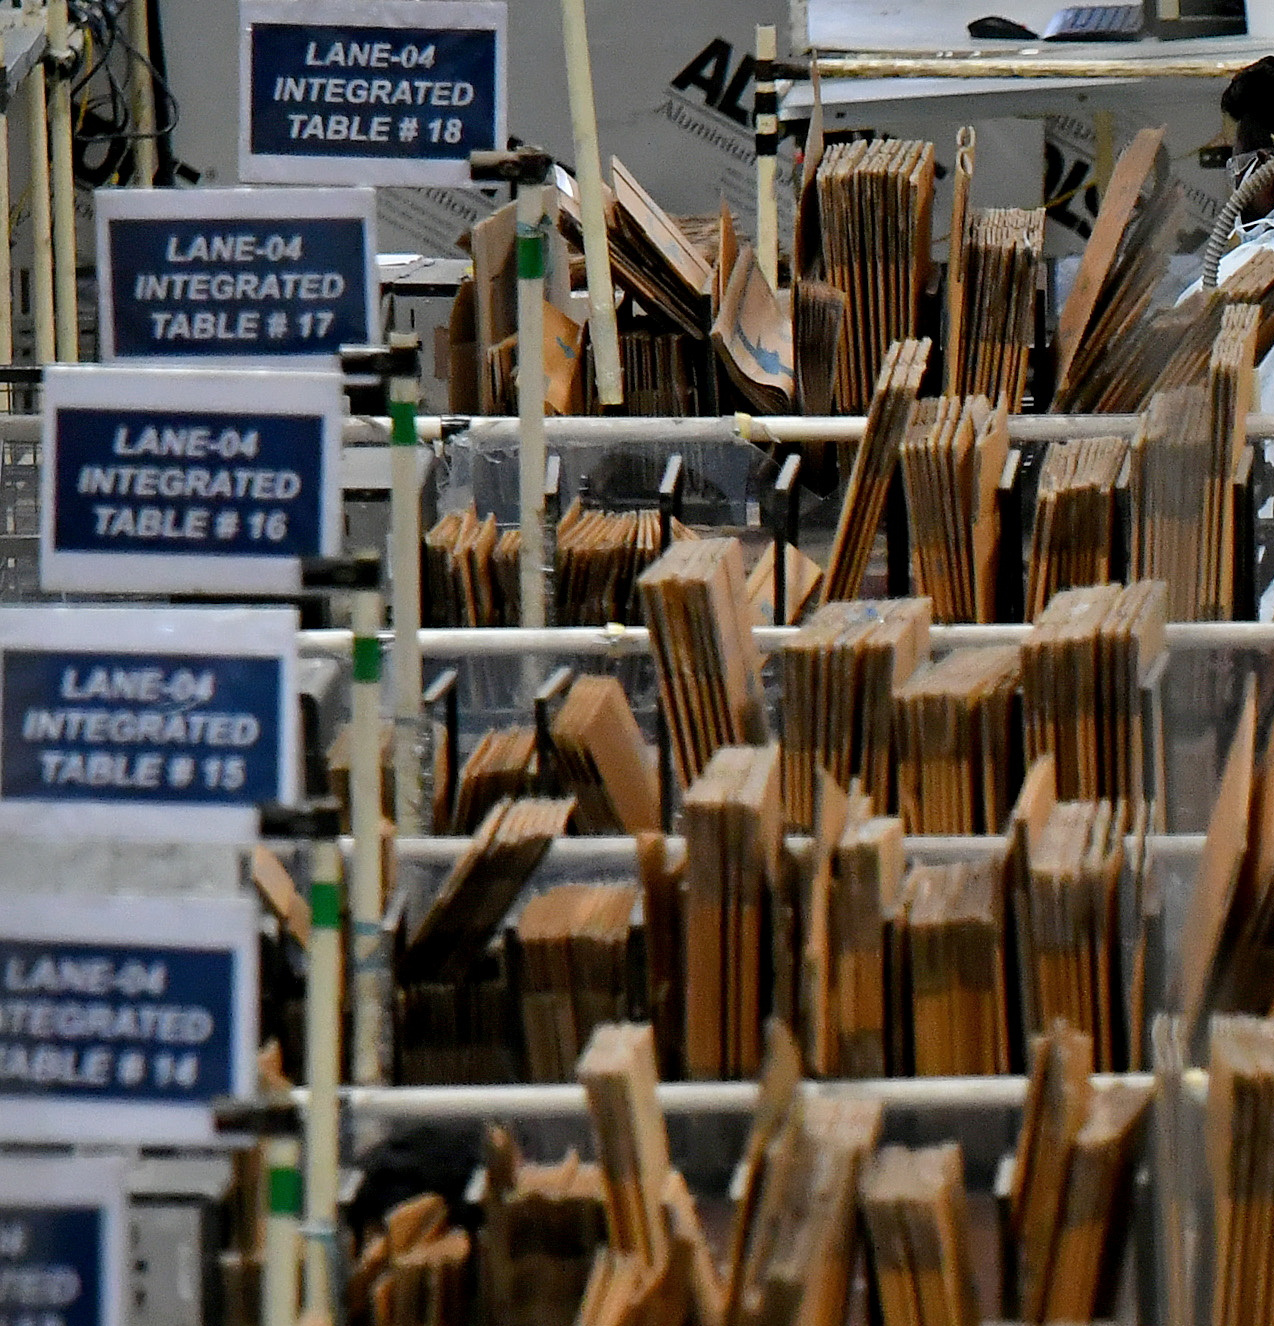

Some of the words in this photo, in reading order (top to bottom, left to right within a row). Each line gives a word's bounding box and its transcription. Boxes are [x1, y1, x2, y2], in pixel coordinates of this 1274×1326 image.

[305, 41, 436, 69] LANE-04
[273, 77, 475, 106] INTEGRATED
[288, 114, 392, 141] TABLE
[398, 117, 419, 142] #
[428, 118, 464, 144] 18
[166, 233, 303, 262] LANE-04
[135, 273, 345, 299] INTEGRATED
[151, 311, 260, 339] TABLE
[267, 312, 288, 339] #
[298, 312, 335, 339] 17
[114, 424, 260, 457] LANE-04
[77, 465, 301, 499] INTEGRATED
[94, 505, 211, 538] TABLE
[215, 509, 240, 540] #
[249, 510, 289, 542] 16
[61, 665, 216, 700] LANE-04
[23, 707, 260, 747] INTEGRATED
[42, 752, 163, 787] TABLE
[203, 755, 246, 791] 15
[5, 955, 170, 998] LANE-04
